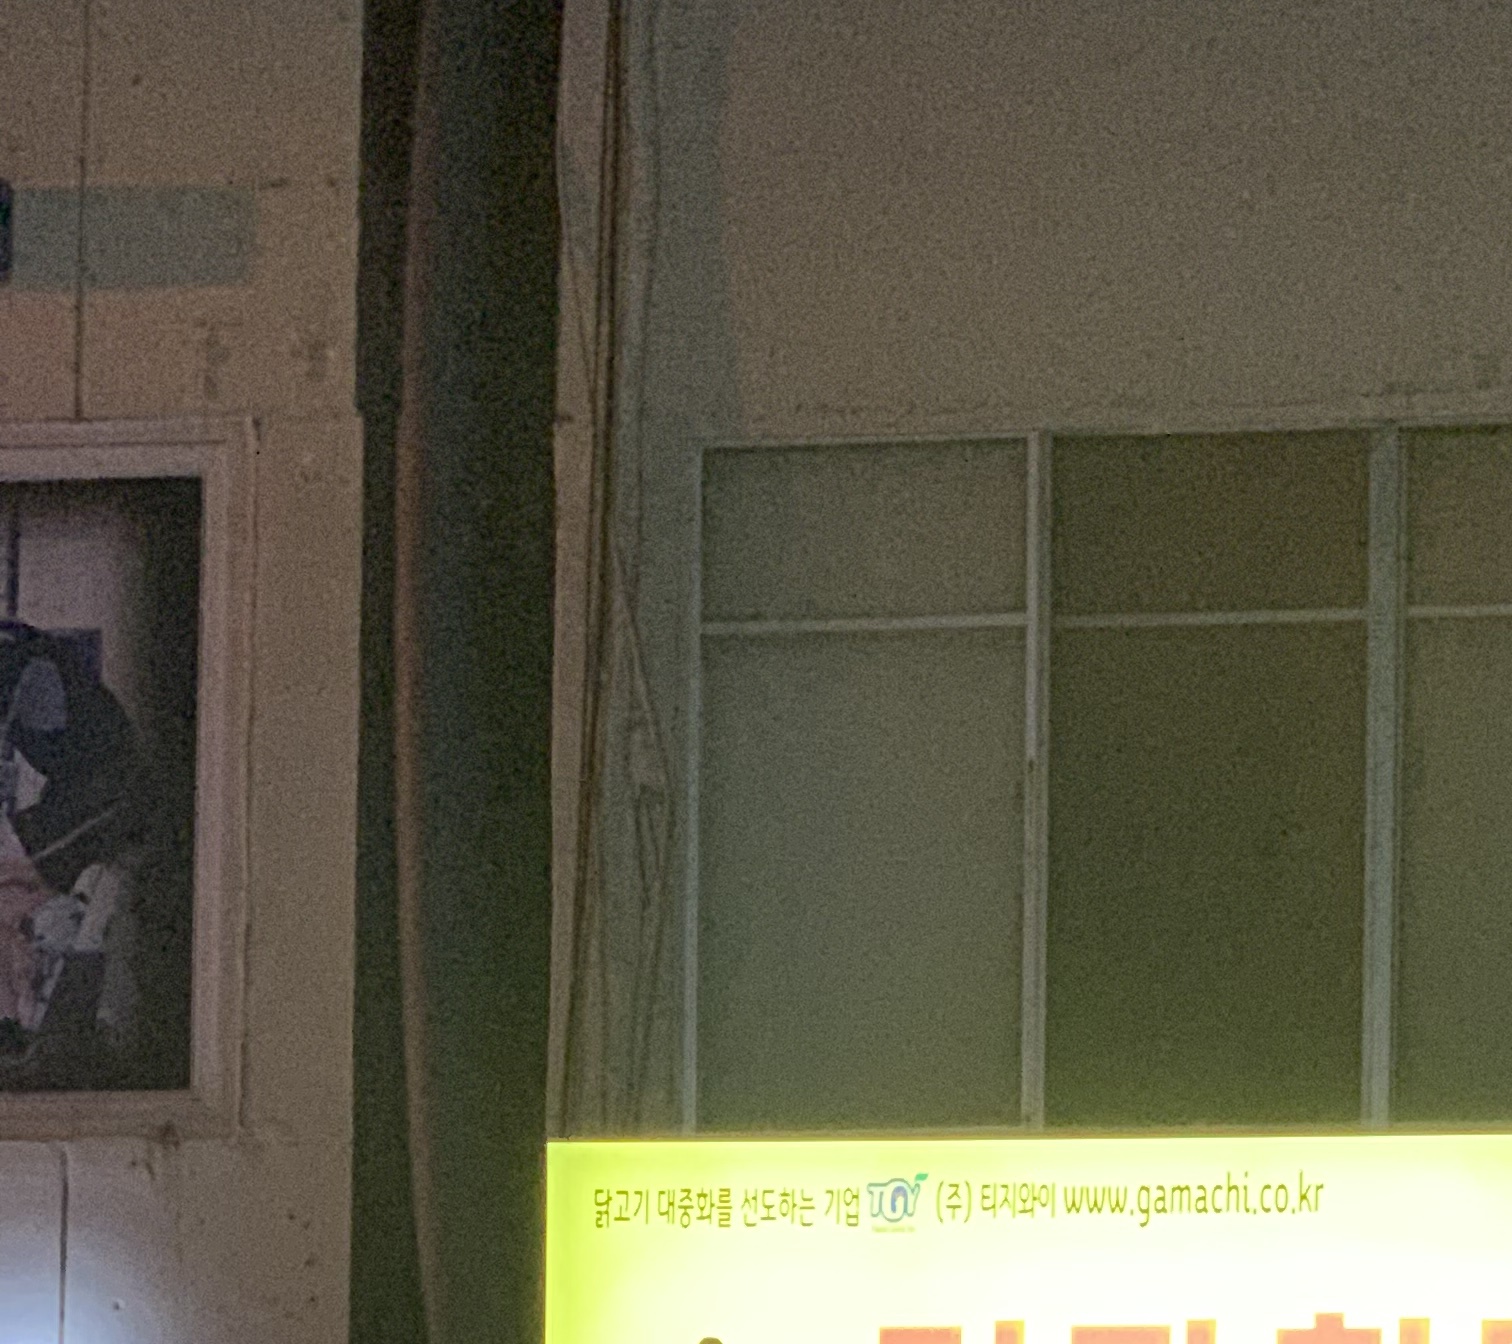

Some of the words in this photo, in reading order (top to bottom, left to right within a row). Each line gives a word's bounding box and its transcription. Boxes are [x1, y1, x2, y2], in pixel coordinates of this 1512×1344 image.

[594, 1187, 650, 1230] 닭고기
[657, 1187, 734, 1230] 대중화를
[740, 1186, 817, 1228] 선도하는
[824, 1186, 861, 1228] 기업
[935, 1180, 973, 1224] (주)
[980, 1181, 1057, 1220] 티지와이
[1063, 1169, 1325, 1229] www.gamachi.co.kr
